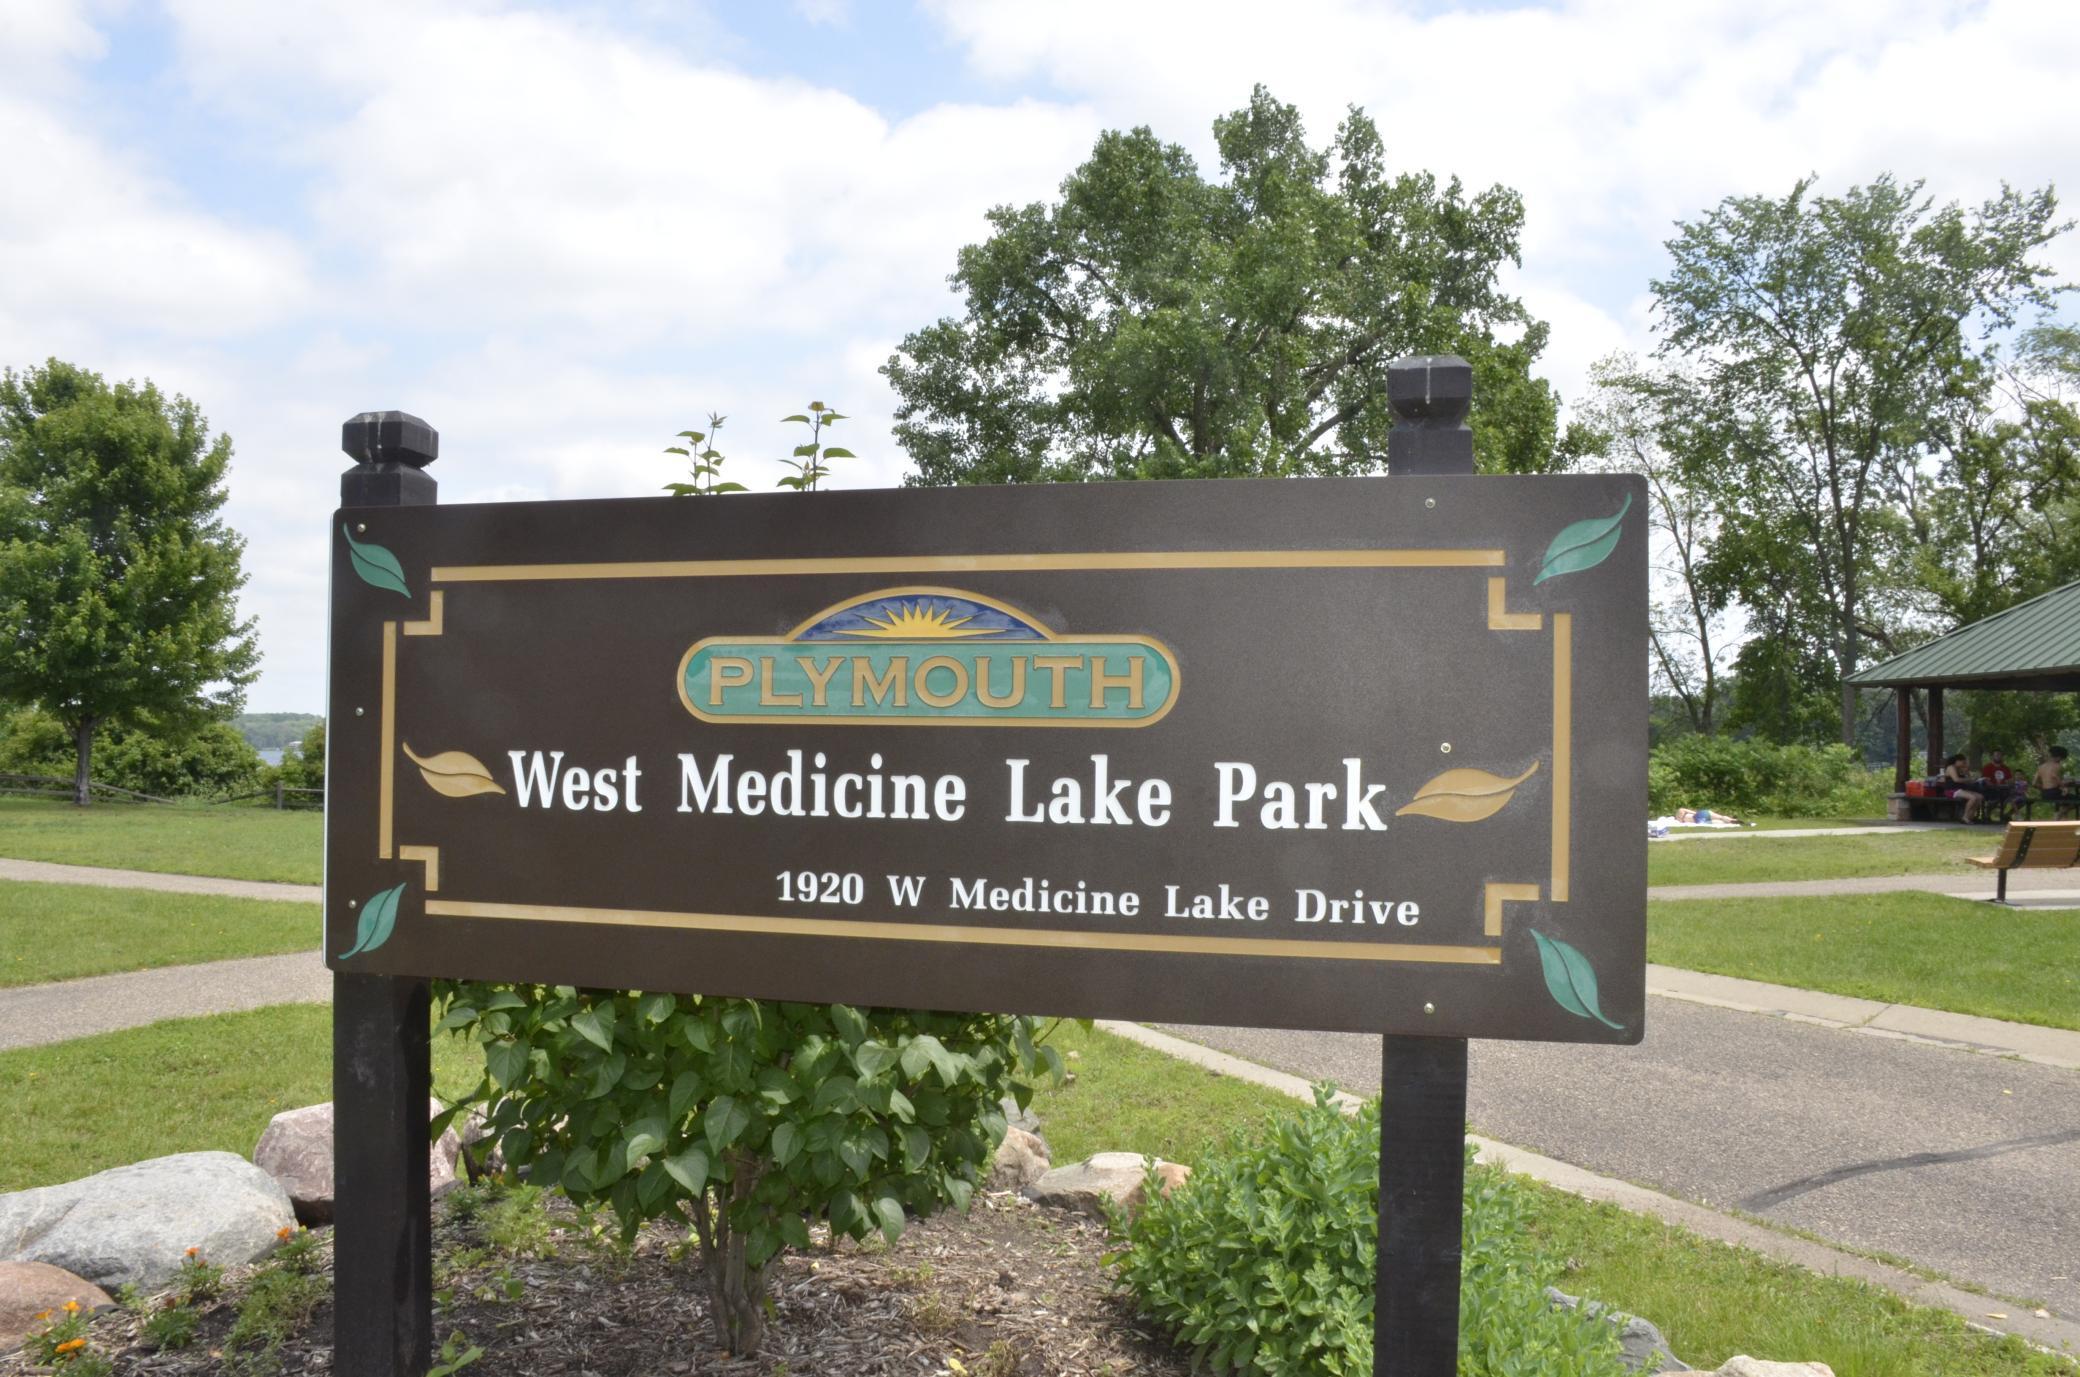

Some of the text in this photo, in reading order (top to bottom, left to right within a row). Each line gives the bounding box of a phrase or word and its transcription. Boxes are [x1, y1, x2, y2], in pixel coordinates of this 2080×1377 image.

[708, 655, 1145, 709] PLYMOUTH
[507, 749, 1388, 832] West Medicine Lake Park
[776, 870, 1420, 926] 1920 W Medicine Lake Drive
